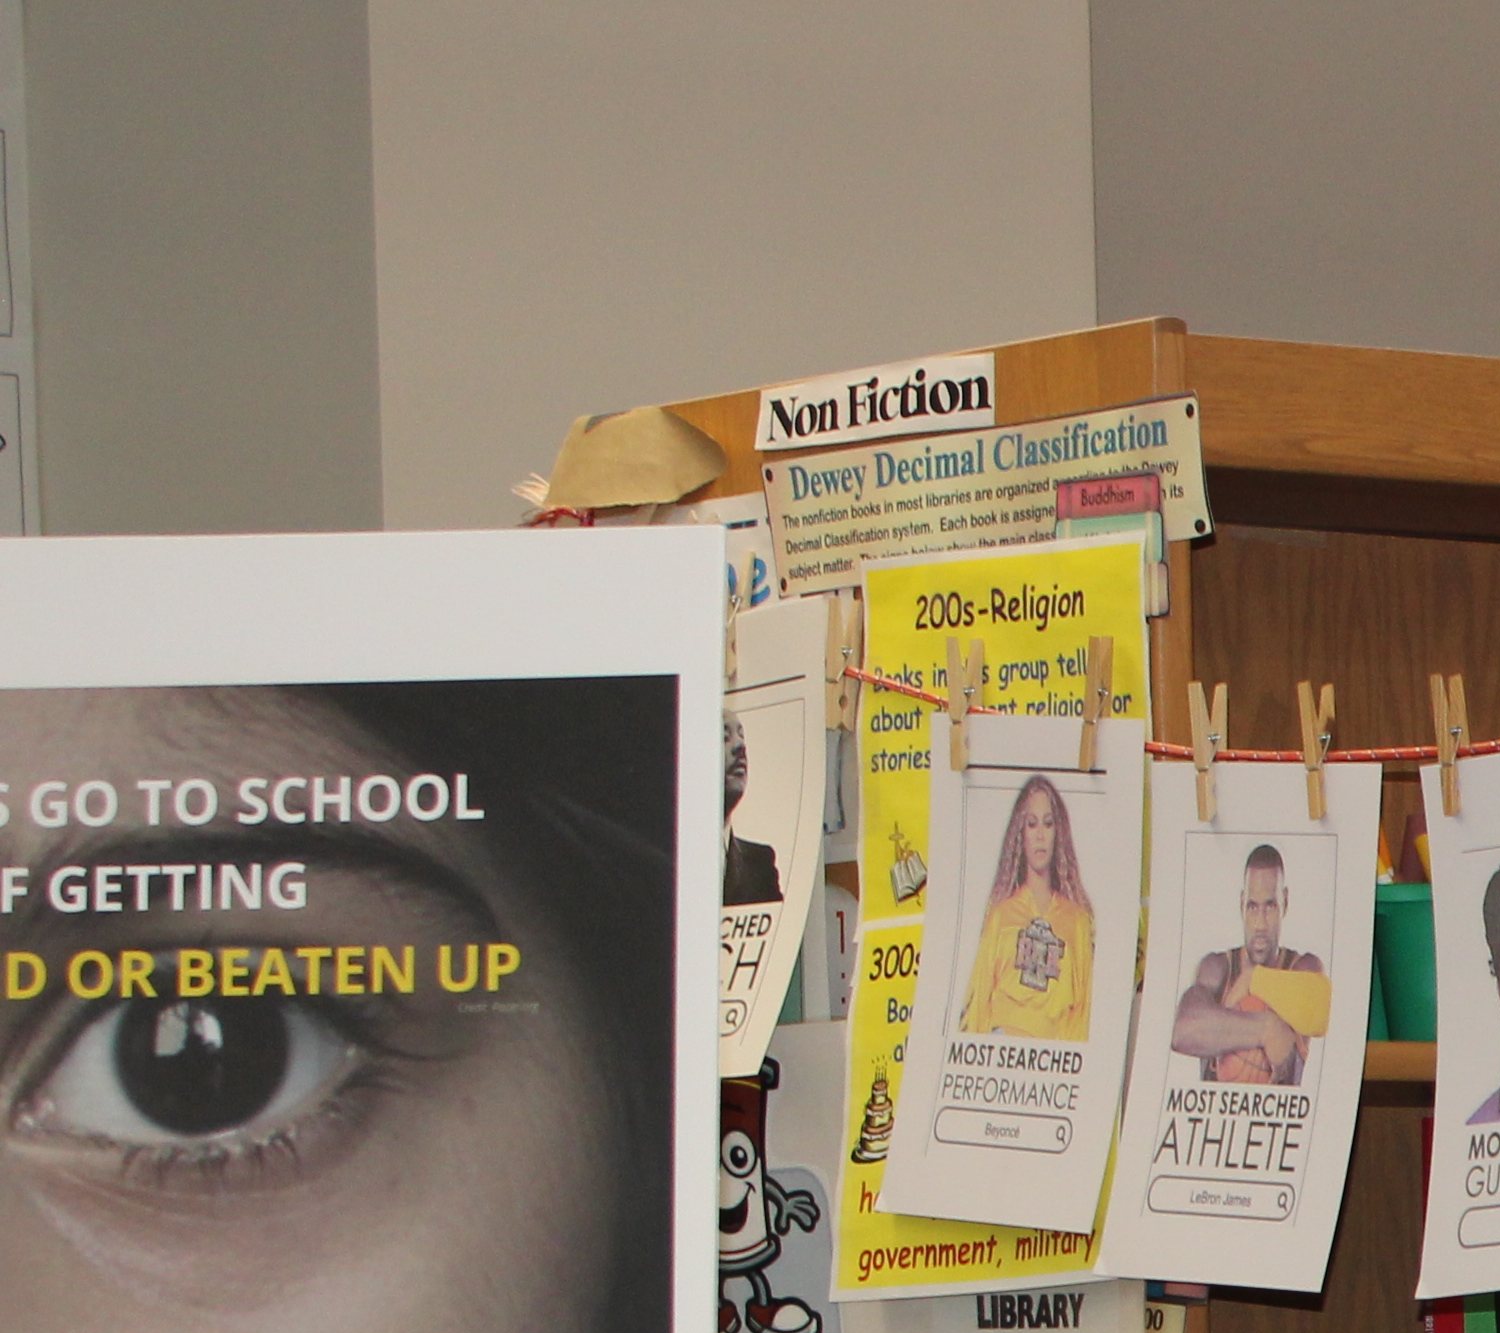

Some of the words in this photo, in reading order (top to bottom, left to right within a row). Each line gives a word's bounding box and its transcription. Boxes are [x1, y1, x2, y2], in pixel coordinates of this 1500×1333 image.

[767, 394, 840, 442] Non
[846, 368, 992, 425] Fiction
[789, 451, 867, 505] Dewey
[874, 440, 985, 488] Decimal
[993, 415, 1169, 469] Classification
[783, 514, 800, 530] The
[802, 505, 849, 527] nonfiction
[851, 504, 881, 519] books
[884, 501, 893, 514] in
[896, 497, 924, 512] most
[926, 490, 972, 508] libraries
[975, 488, 993, 501] are
[996, 478, 1050, 500] organized
[915, 584, 1085, 630] 200s-Religion
[999, 660, 1050, 688] group
[30, 780, 119, 829] GO
[136, 779, 219, 825] TO
[237, 773, 485, 827] SCHOOL
[48, 862, 308, 914] GETTING
[67, 949, 157, 1000] OR
[178, 945, 418, 997] BEATEN
[436, 942, 521, 993] UP
[948, 1042, 993, 1069] MOST
[998, 1047, 1083, 1076] SEARCHED
[941, 1073, 1079, 1112] PERFORMANCE
[1166, 1087, 1216, 1114] MOST
[1218, 1090, 1310, 1120] SEARCHED
[1152, 1117, 1303, 1173] ATHLETE
[1189, 1190, 1220, 1206] LeBron
[1222, 1192, 1252, 1208] James
[858, 1233, 1004, 1282] government,
[1015, 1226, 1095, 1263] military
[977, 1293, 1085, 1330] LIBRARY
